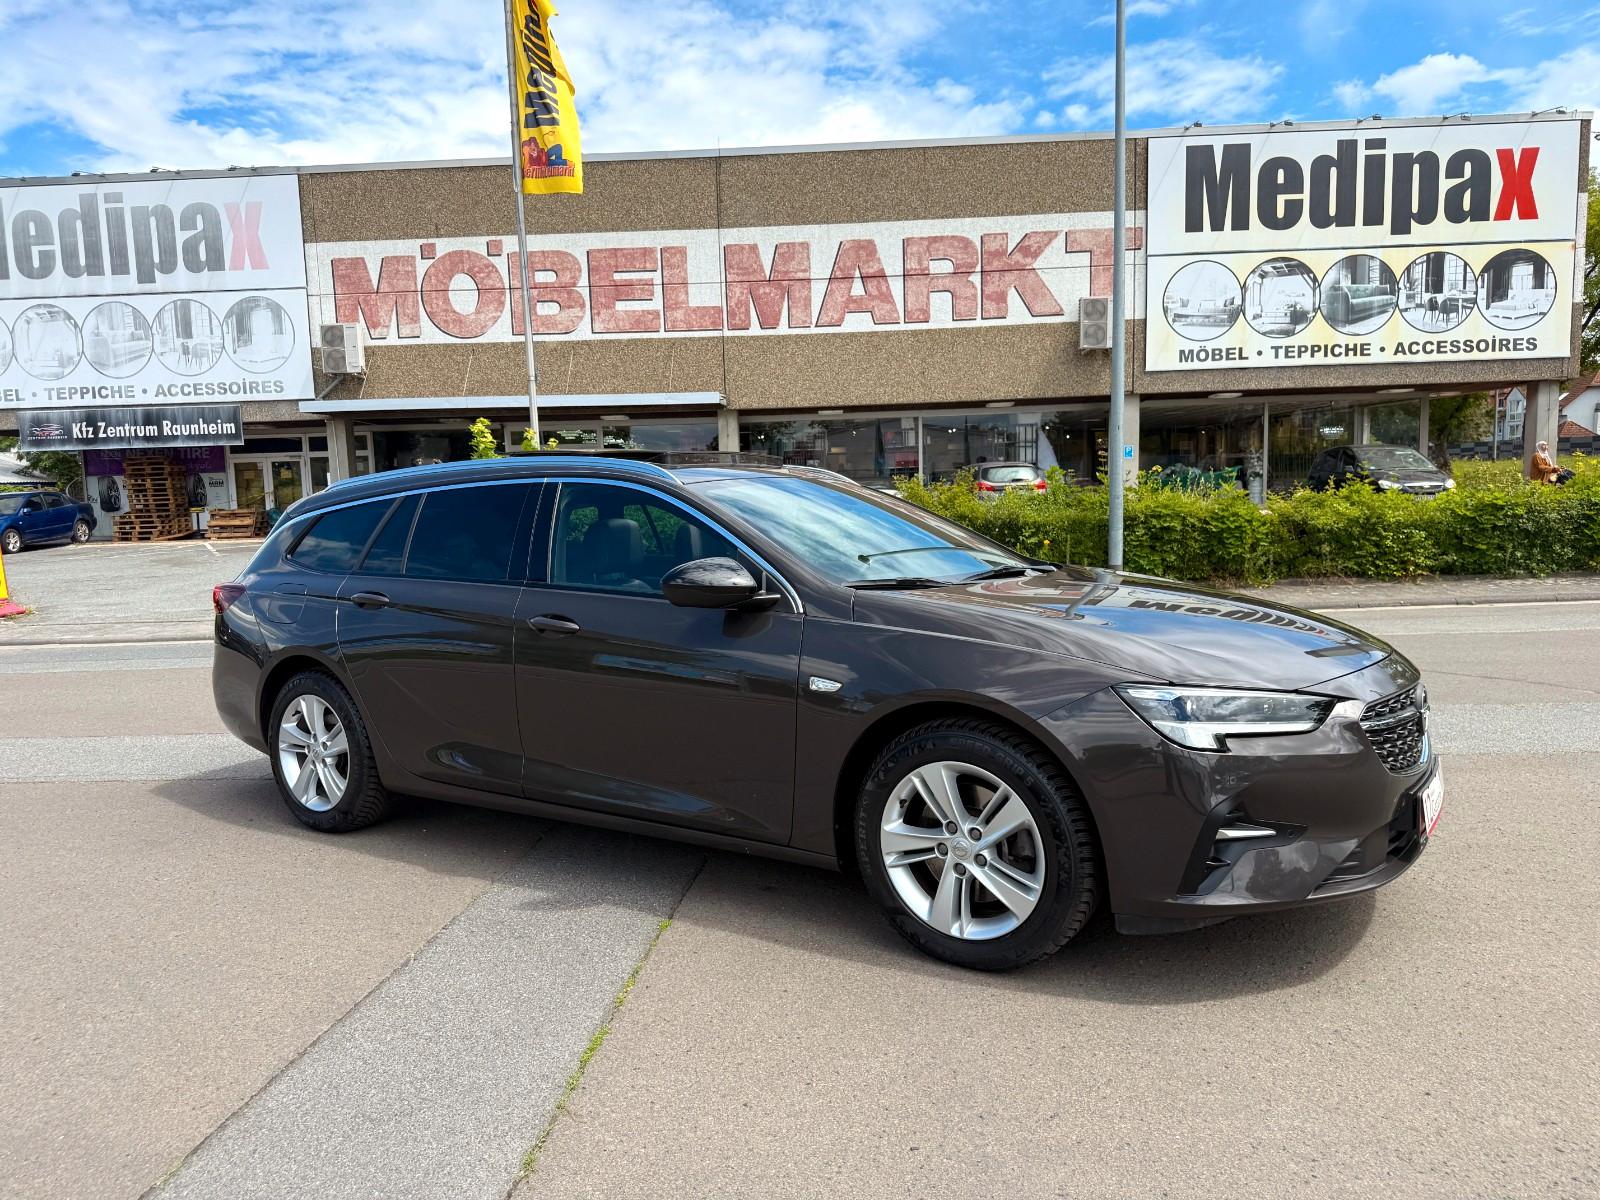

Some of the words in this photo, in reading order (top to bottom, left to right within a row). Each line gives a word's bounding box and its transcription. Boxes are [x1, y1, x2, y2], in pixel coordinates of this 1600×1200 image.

[1184, 137, 1540, 236] Medipax
[331, 227, 1143, 339] MÖBELMARKT
[1178, 345, 1250, 364] MÖBEL
[1270, 342, 1372, 360] TEPPICHE
[43, 384, 135, 401] TEPPICHE
[72, 422, 95, 439] Kfz
[97, 421, 158, 438] Zentrum
[163, 419, 236, 436] Raunheim
[177, 447, 210, 459] TIRE
